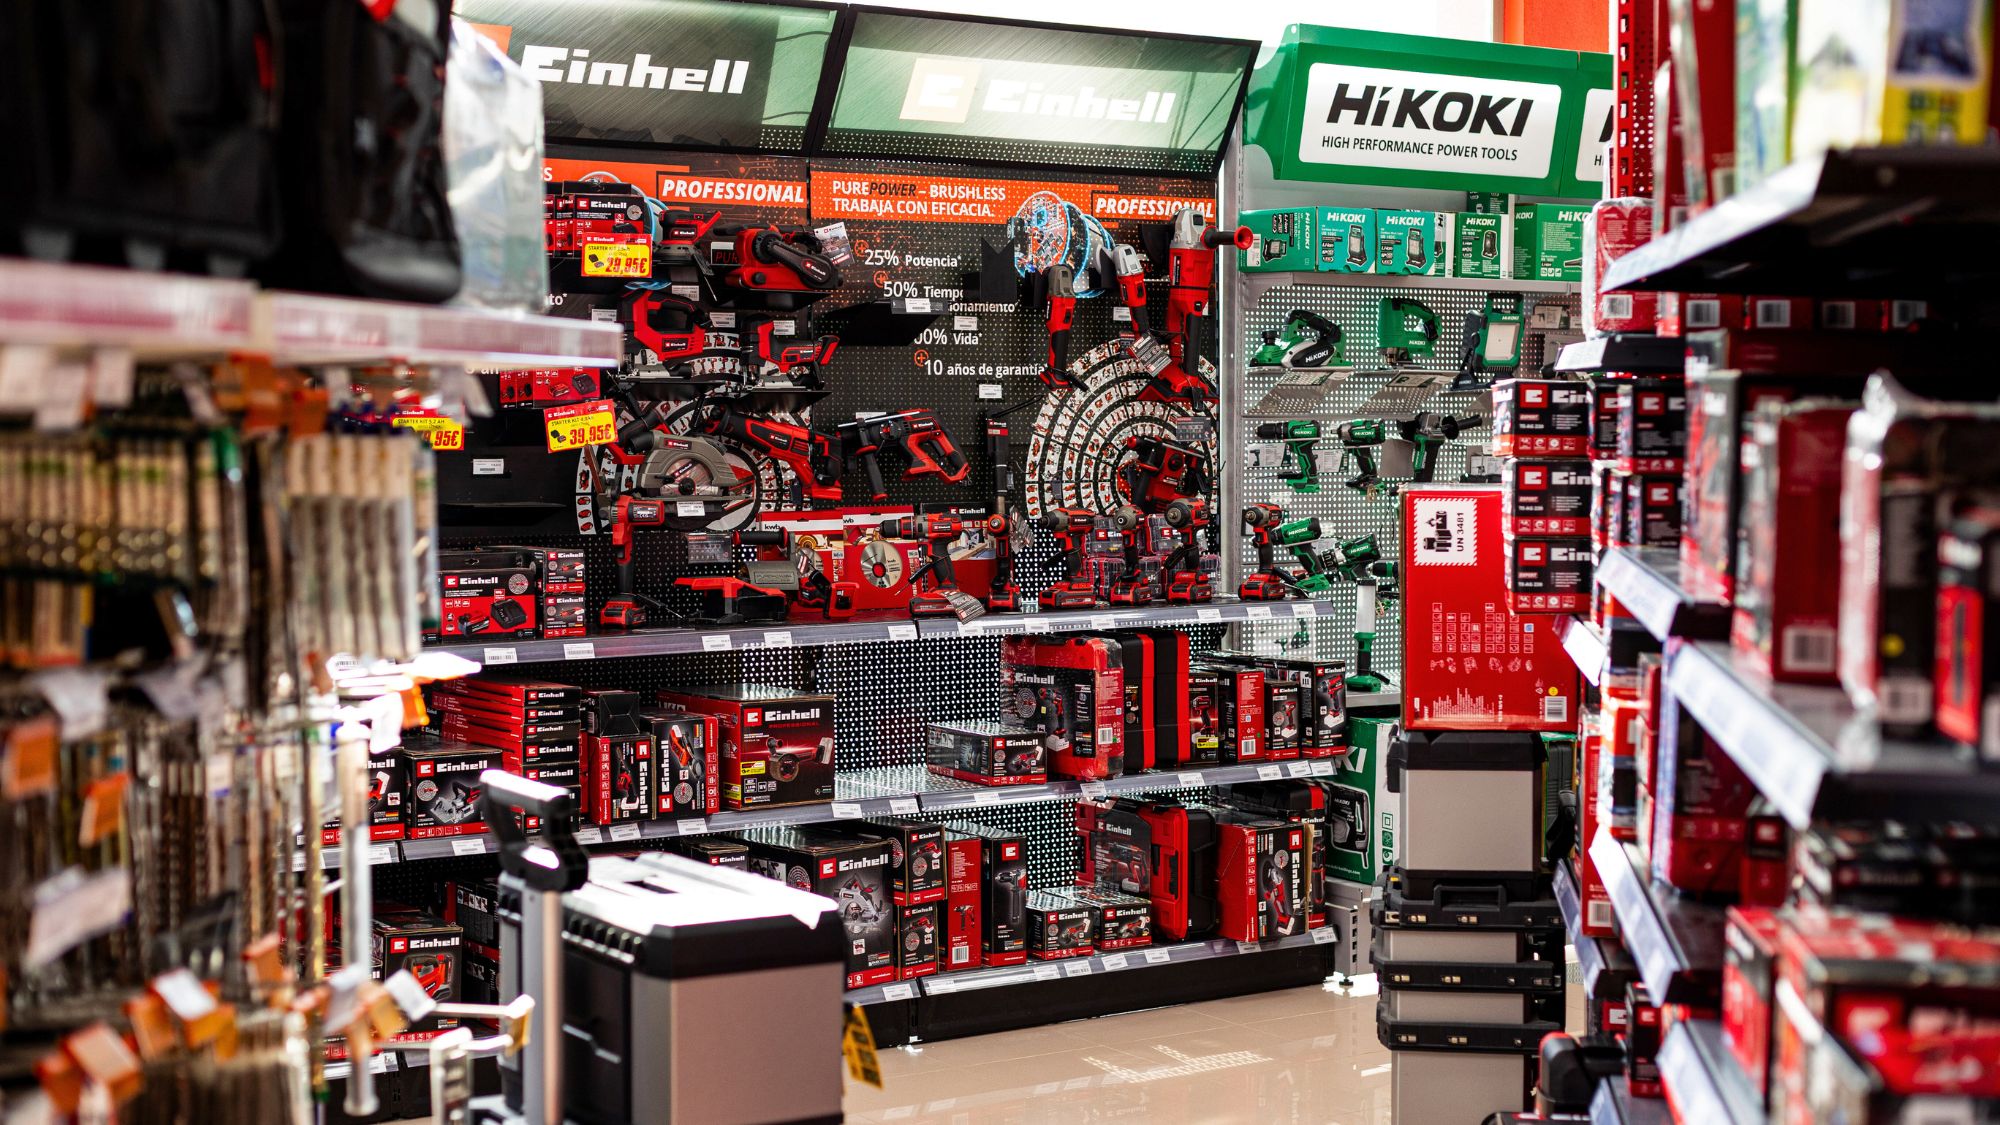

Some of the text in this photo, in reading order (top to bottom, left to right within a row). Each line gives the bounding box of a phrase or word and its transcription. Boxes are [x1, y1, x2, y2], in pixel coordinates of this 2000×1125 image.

[521, 44, 749, 95] Einhell
[982, 78, 1177, 123] Einhell
[1322, 135, 1518, 161] HIGH PERFORMANCE POWER TOOLS
[662, 179, 804, 204] PROFESSIONAL
[929, 184, 1006, 201] BRUSHLESS
[590, 200, 627, 209] Einhell
[832, 198, 894, 217] TRABAJA
[896, 200, 928, 215] CON
[864, 249, 899, 266] 25%
[605, 256, 648, 275] 29,95€
[883, 280, 918, 298] 50%
[924, 359, 943, 376] 10
[946, 362, 976, 376] años
[978, 362, 994, 376] de
[958, 507, 986, 515] Einhell
[1457, 511, 1465, 552] UN 3481
[459, 576, 499, 585] Einhell
[1015, 672, 1055, 685] Einhell
[538, 691, 565, 699] Einhell
[537, 709, 564, 717] Einhell
[764, 708, 820, 722] Einhell
[536, 725, 564, 733] Einhell
[1006, 738, 1039, 747] Einhell
[539, 745, 574, 754] Einhell
[436, 759, 488, 773] Einhell
[660, 740, 670, 793] Einhell
[539, 768, 574, 778] Einhell
[639, 761, 649, 814] Einhell
[919, 831, 941, 840] Einhell
[1105, 823, 1132, 836] Einhell
[719, 855, 746, 863] Einhell
[838, 854, 889, 872] Einhell
[1291, 852, 1301, 909] Einhell
[911, 906, 933, 915] Einhell
[1058, 911, 1089, 921] Einhell
[1116, 907, 1147, 917] Einhell
[409, 936, 460, 949] Einhell
